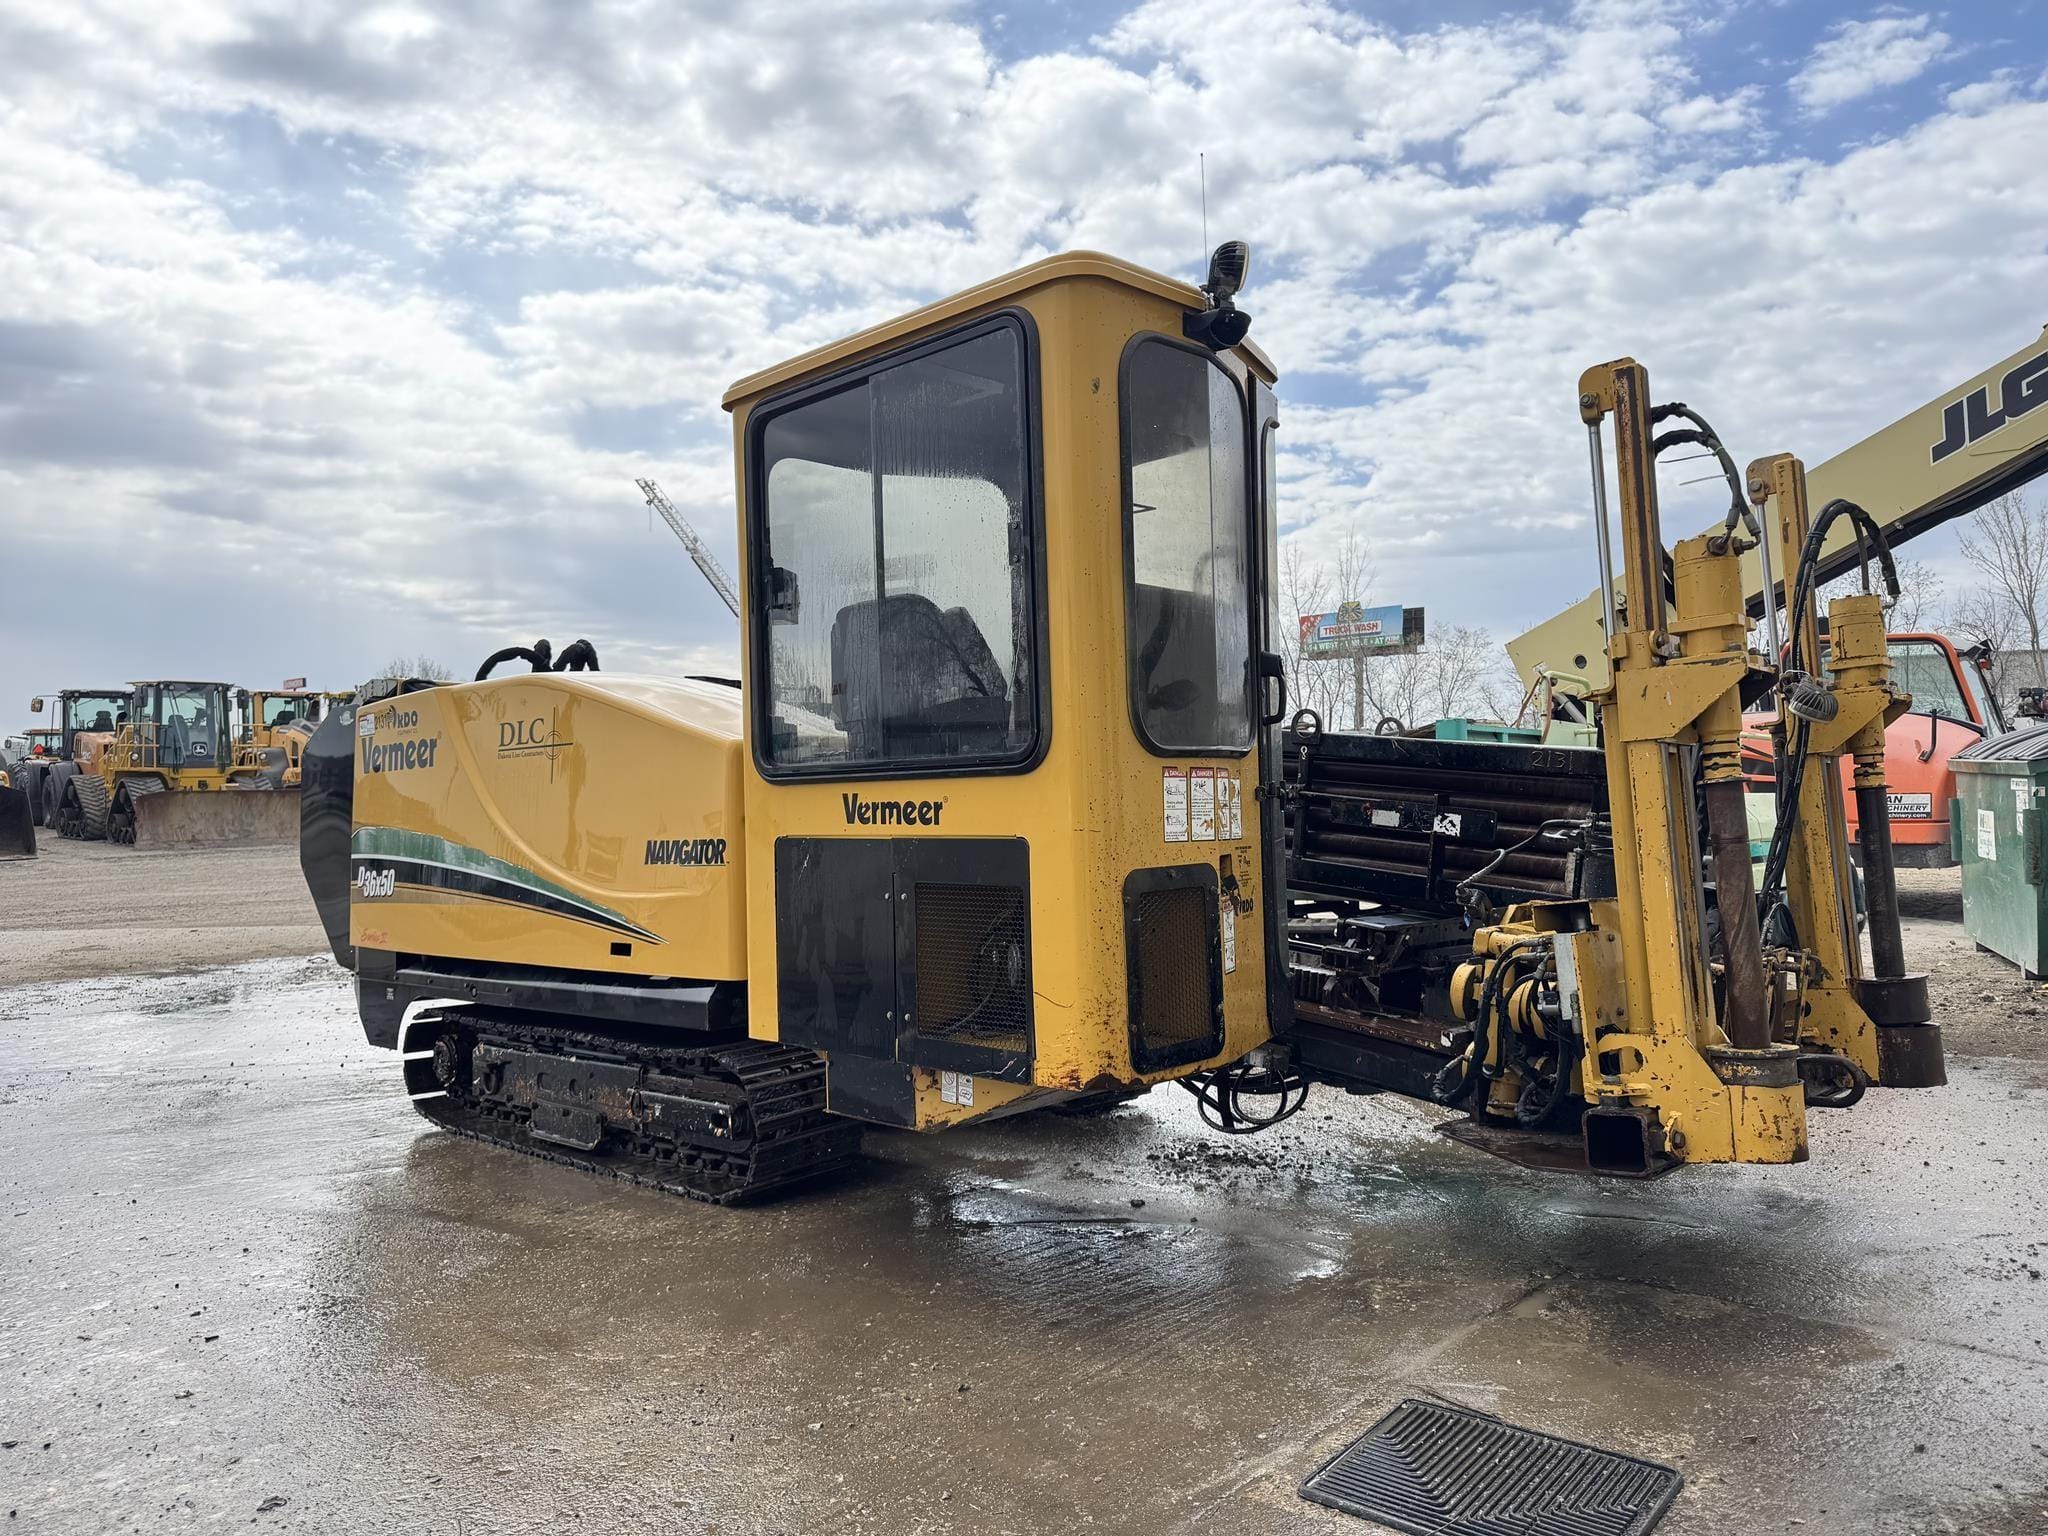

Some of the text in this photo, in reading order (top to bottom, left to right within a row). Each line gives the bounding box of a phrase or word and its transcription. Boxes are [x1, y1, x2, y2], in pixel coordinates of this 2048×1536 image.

[1930, 350, 2048, 464] JLG
[1354, 621, 1379, 633] WASH
[499, 718, 545, 747] DLC
[361, 736, 438, 774] Vermeer
[842, 793, 943, 826] Vermeer
[1887, 795, 1903, 804] AN
[644, 838, 727, 866] NAVIGATOR
[357, 866, 396, 898] D36x50
